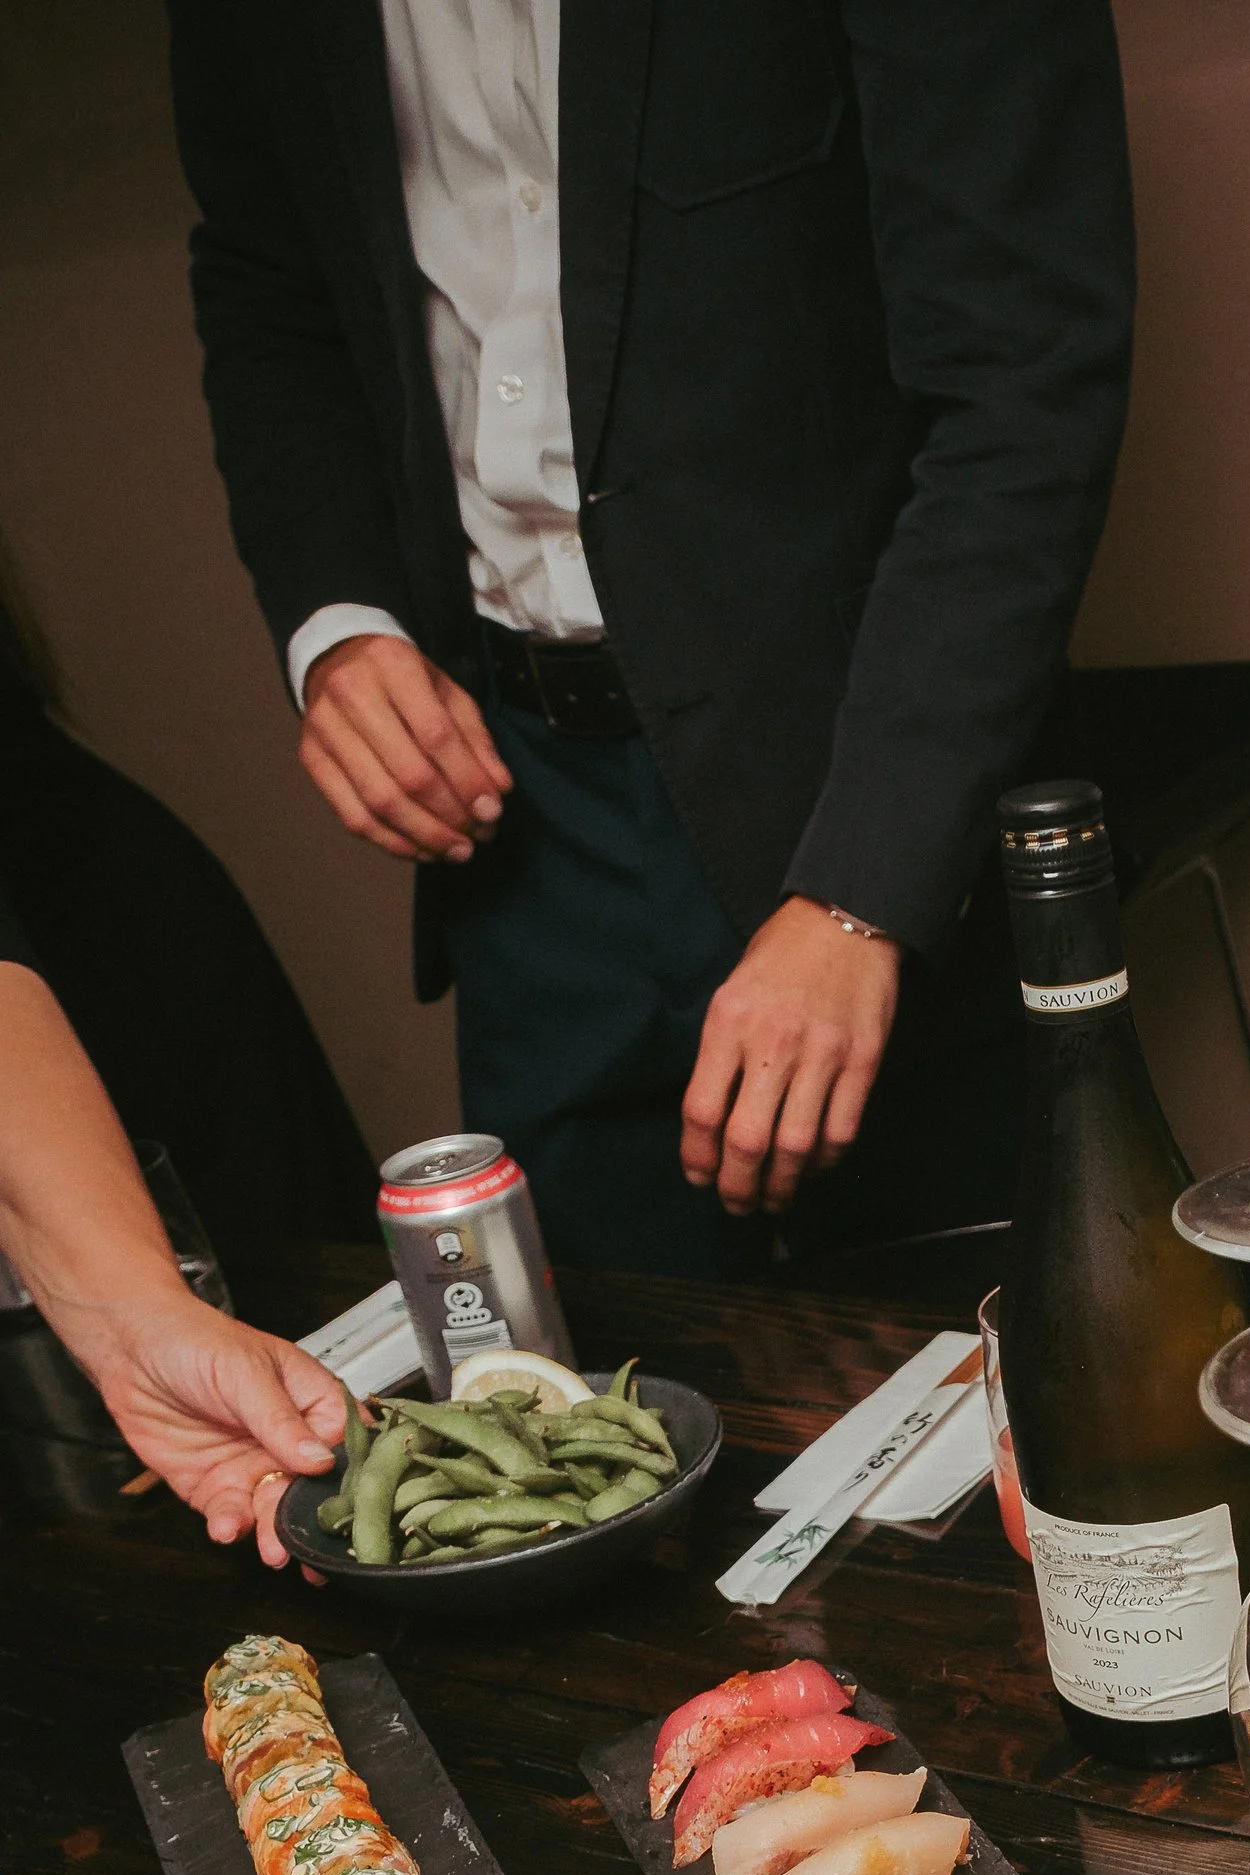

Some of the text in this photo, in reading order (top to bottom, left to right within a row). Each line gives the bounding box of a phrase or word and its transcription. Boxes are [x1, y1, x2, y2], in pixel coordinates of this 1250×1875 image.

[1040, 983, 1118, 1007] SAUVION
[1054, 1524, 1081, 1535] PRODUCE
[1046, 1573, 1164, 1622] Les Rafelières
[1046, 1607, 1183, 1645] SAUVIGNON
[1093, 1658, 1119, 1669] 2023
[1074, 1674, 1152, 1697] SAUVION
